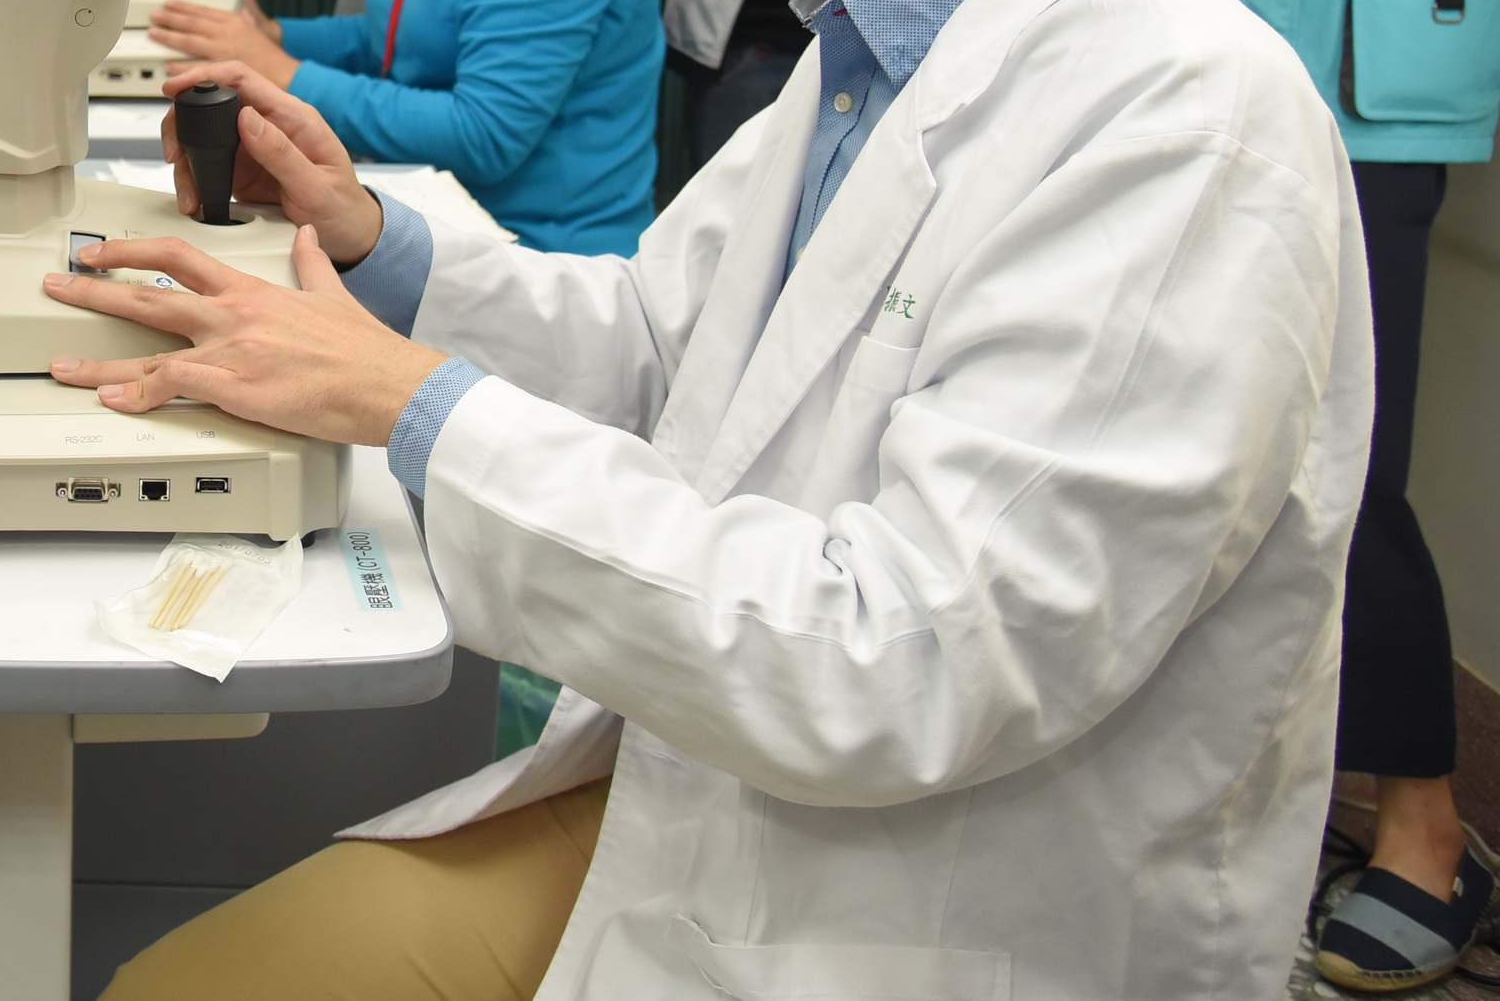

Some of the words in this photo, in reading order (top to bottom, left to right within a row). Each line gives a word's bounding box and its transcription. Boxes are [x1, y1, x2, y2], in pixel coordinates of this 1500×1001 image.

[136, 433, 155, 442] LAN
[196, 430, 216, 439] USB
[65, 435, 103, 444] RS-232C
